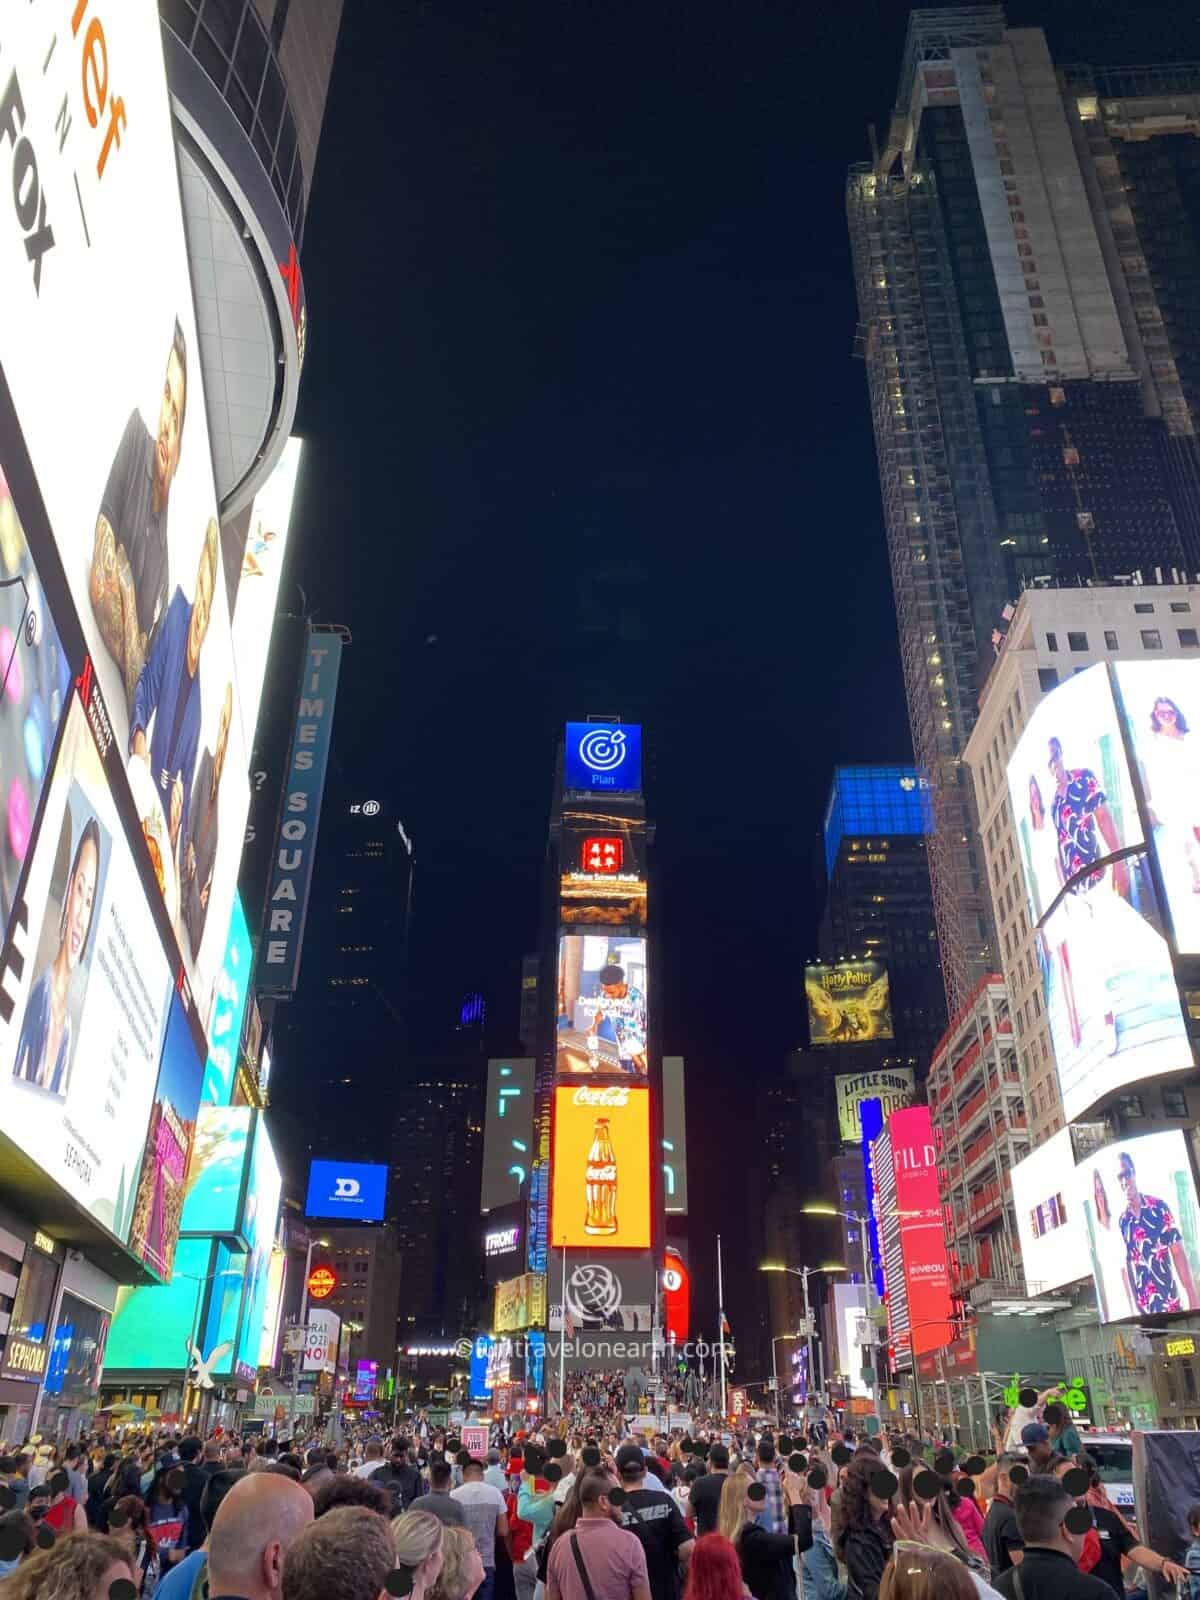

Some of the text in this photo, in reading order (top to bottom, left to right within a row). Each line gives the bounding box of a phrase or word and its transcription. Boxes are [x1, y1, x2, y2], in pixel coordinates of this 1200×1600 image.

[591, 774, 616, 785] Plan
[266, 648, 328, 964] TIMES SQUARE
[822, 973, 846, 988] Harry
[846, 970, 872, 985] Potter
[845, 1074, 908, 1096] LITTLE SHOP
[7, 1341, 46, 1373] SEPHORA
